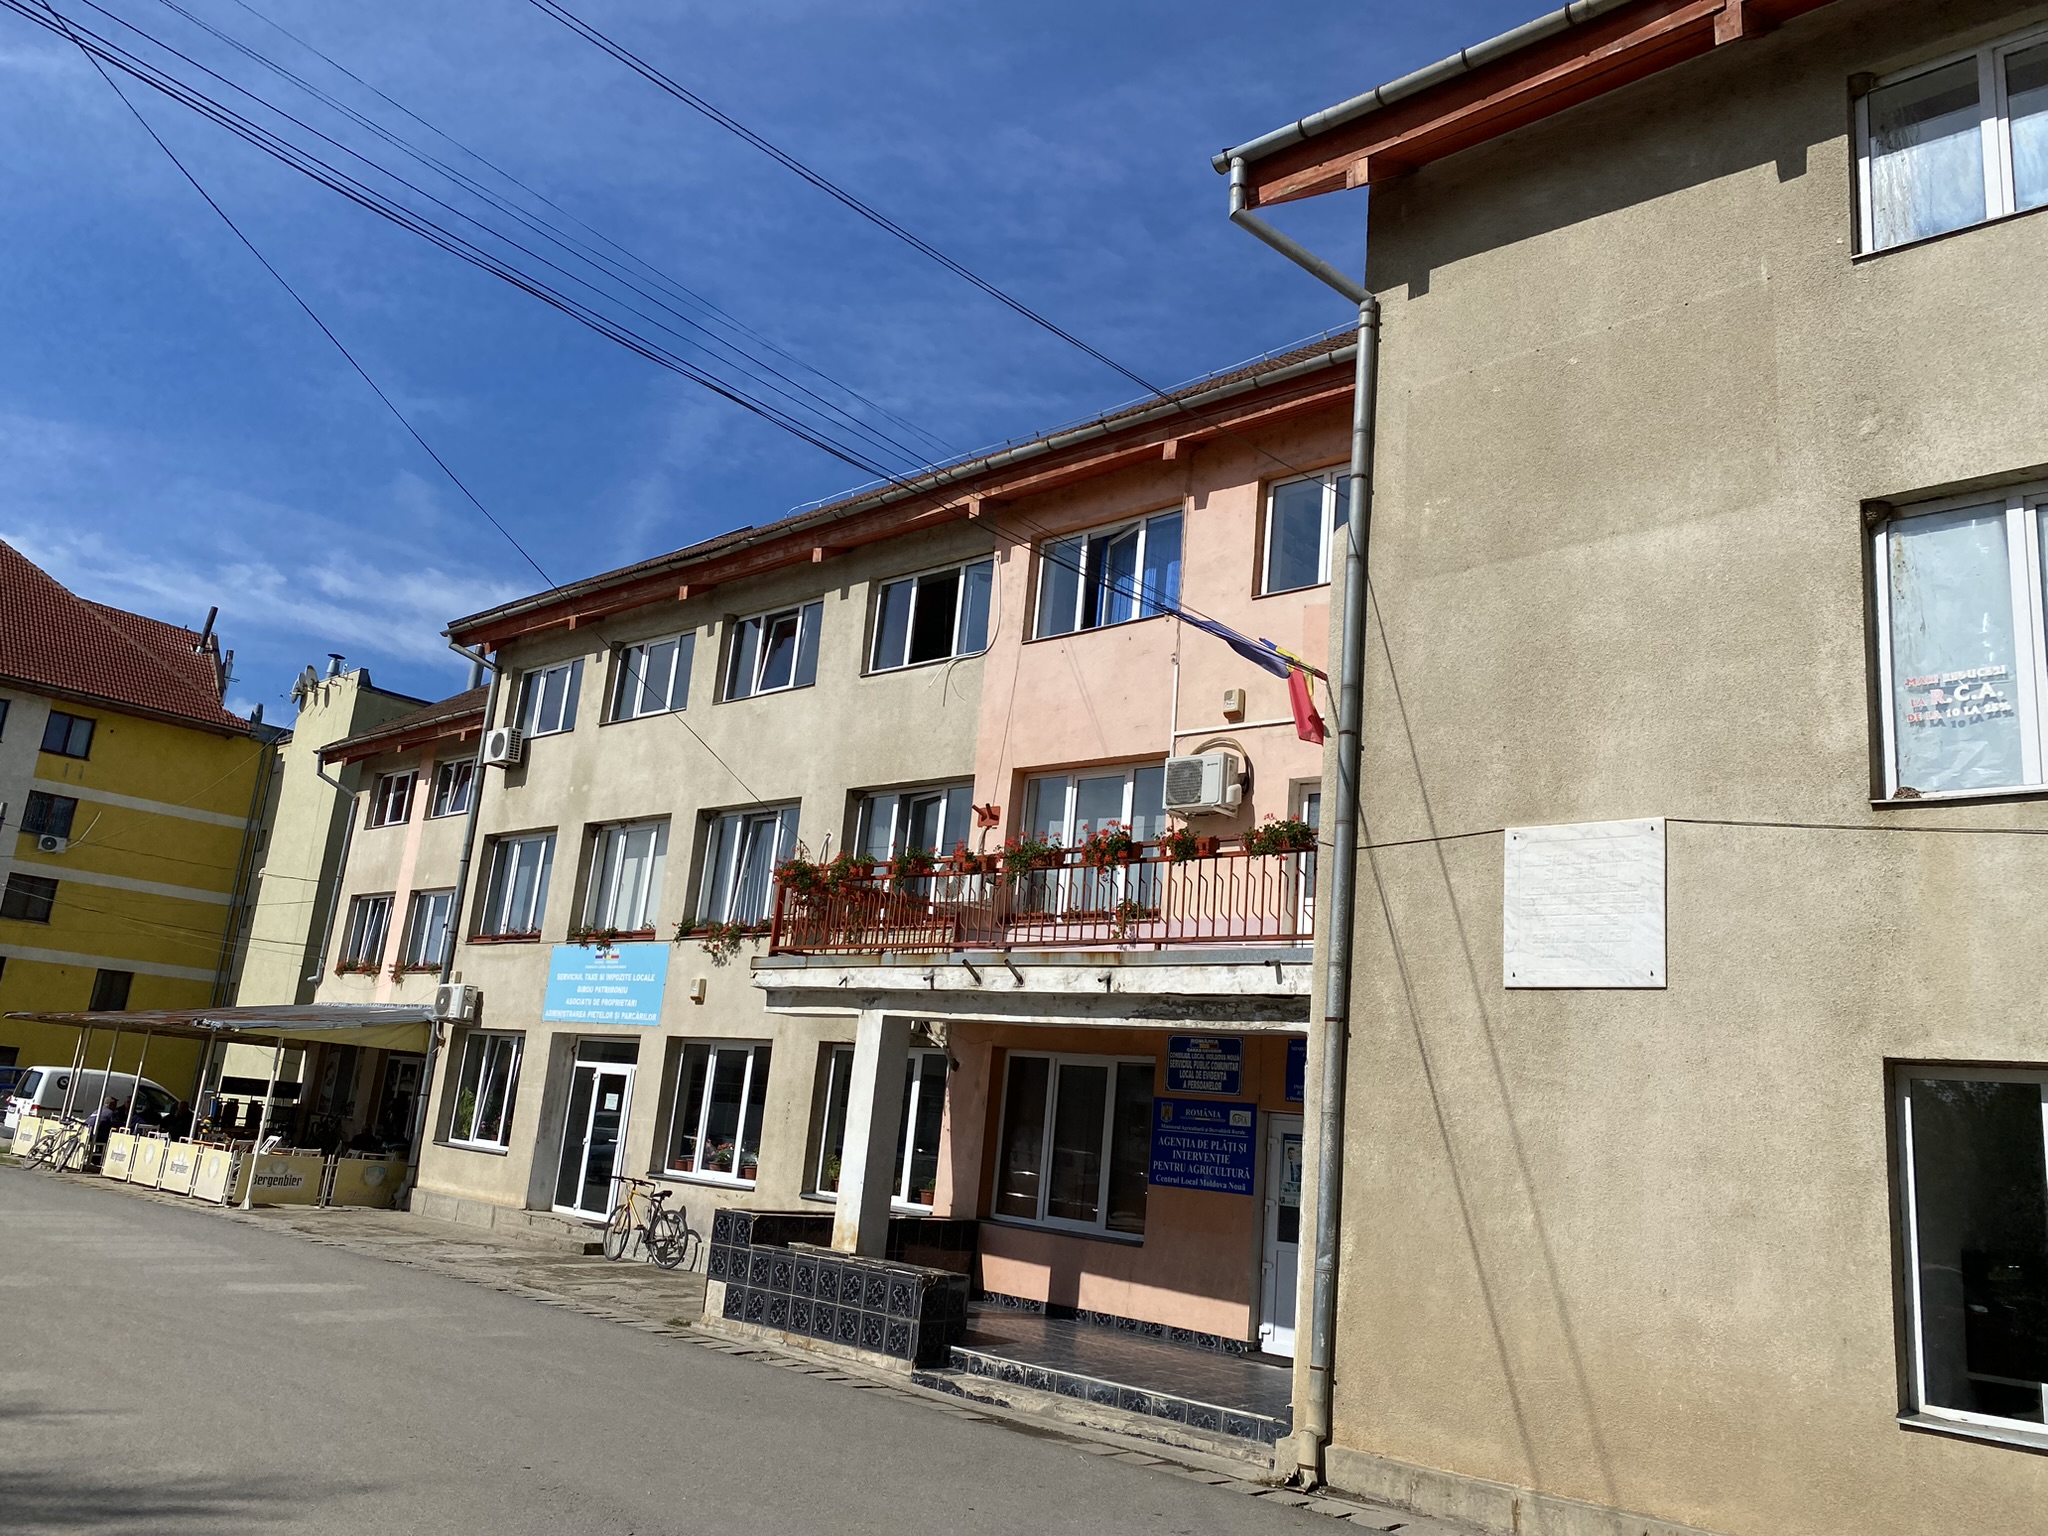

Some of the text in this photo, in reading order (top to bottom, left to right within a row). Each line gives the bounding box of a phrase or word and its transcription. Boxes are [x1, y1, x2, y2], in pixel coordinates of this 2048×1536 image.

[1910, 698, 1925, 707] LA
[1907, 713, 1922, 722] DE
[1946, 708, 1960, 718] 10
[1964, 706, 1981, 715] LA
[1983, 701, 2011, 713] 25%
[584, 973, 598, 981] TAXE
[606, 974, 632, 982] IMPOZITE
[632, 974, 656, 982] LOCALE
[576, 986, 628, 994] BIROU PATRIMONIU
[601, 999, 638, 1007] PROPRIETARI
[1193, 1060, 1210, 1070] PUBLIC
[1211, 1061, 1239, 1072] COMUNITAR
[1179, 1070, 1194, 1079] LOCAL
[1196, 1070, 1202, 1079] DE
[1183, 1080, 1222, 1091] A PERSOANELOR
[1185, 1108, 1221, 1119] ROMÂNIA
[1198, 1139, 1209, 1150] DE
[1153, 1160, 1186, 1173] PENTRU
[1156, 1174, 1180, 1184] Centrul
[1180, 1176, 1198, 1186] Local
[1199, 1178, 1227, 1188] Moldova
